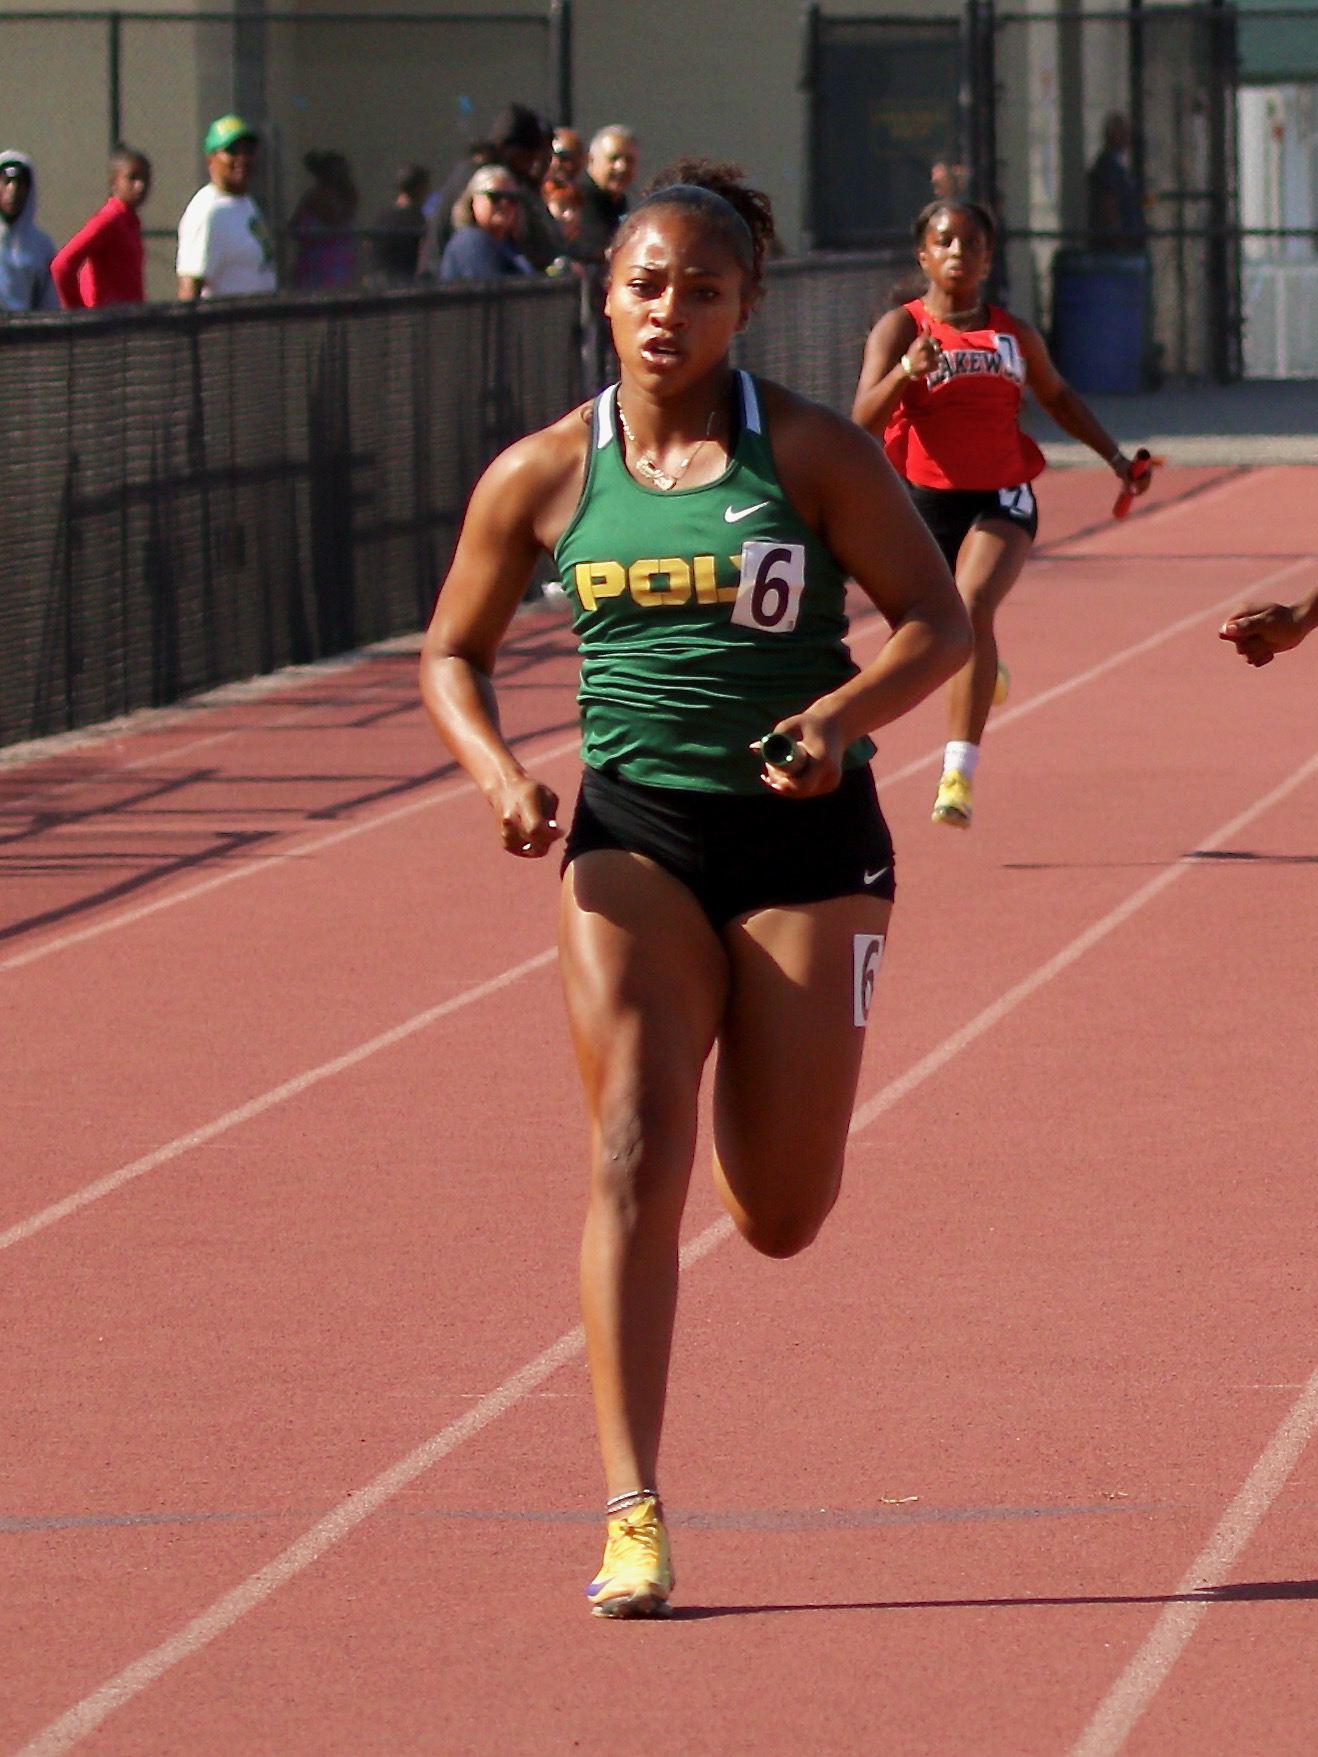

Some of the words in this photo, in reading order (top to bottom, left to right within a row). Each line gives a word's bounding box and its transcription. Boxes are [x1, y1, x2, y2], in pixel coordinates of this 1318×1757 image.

[574, 553, 743, 612] POL
[751, 548, 792, 628] 6
[861, 939, 880, 1022] 6
